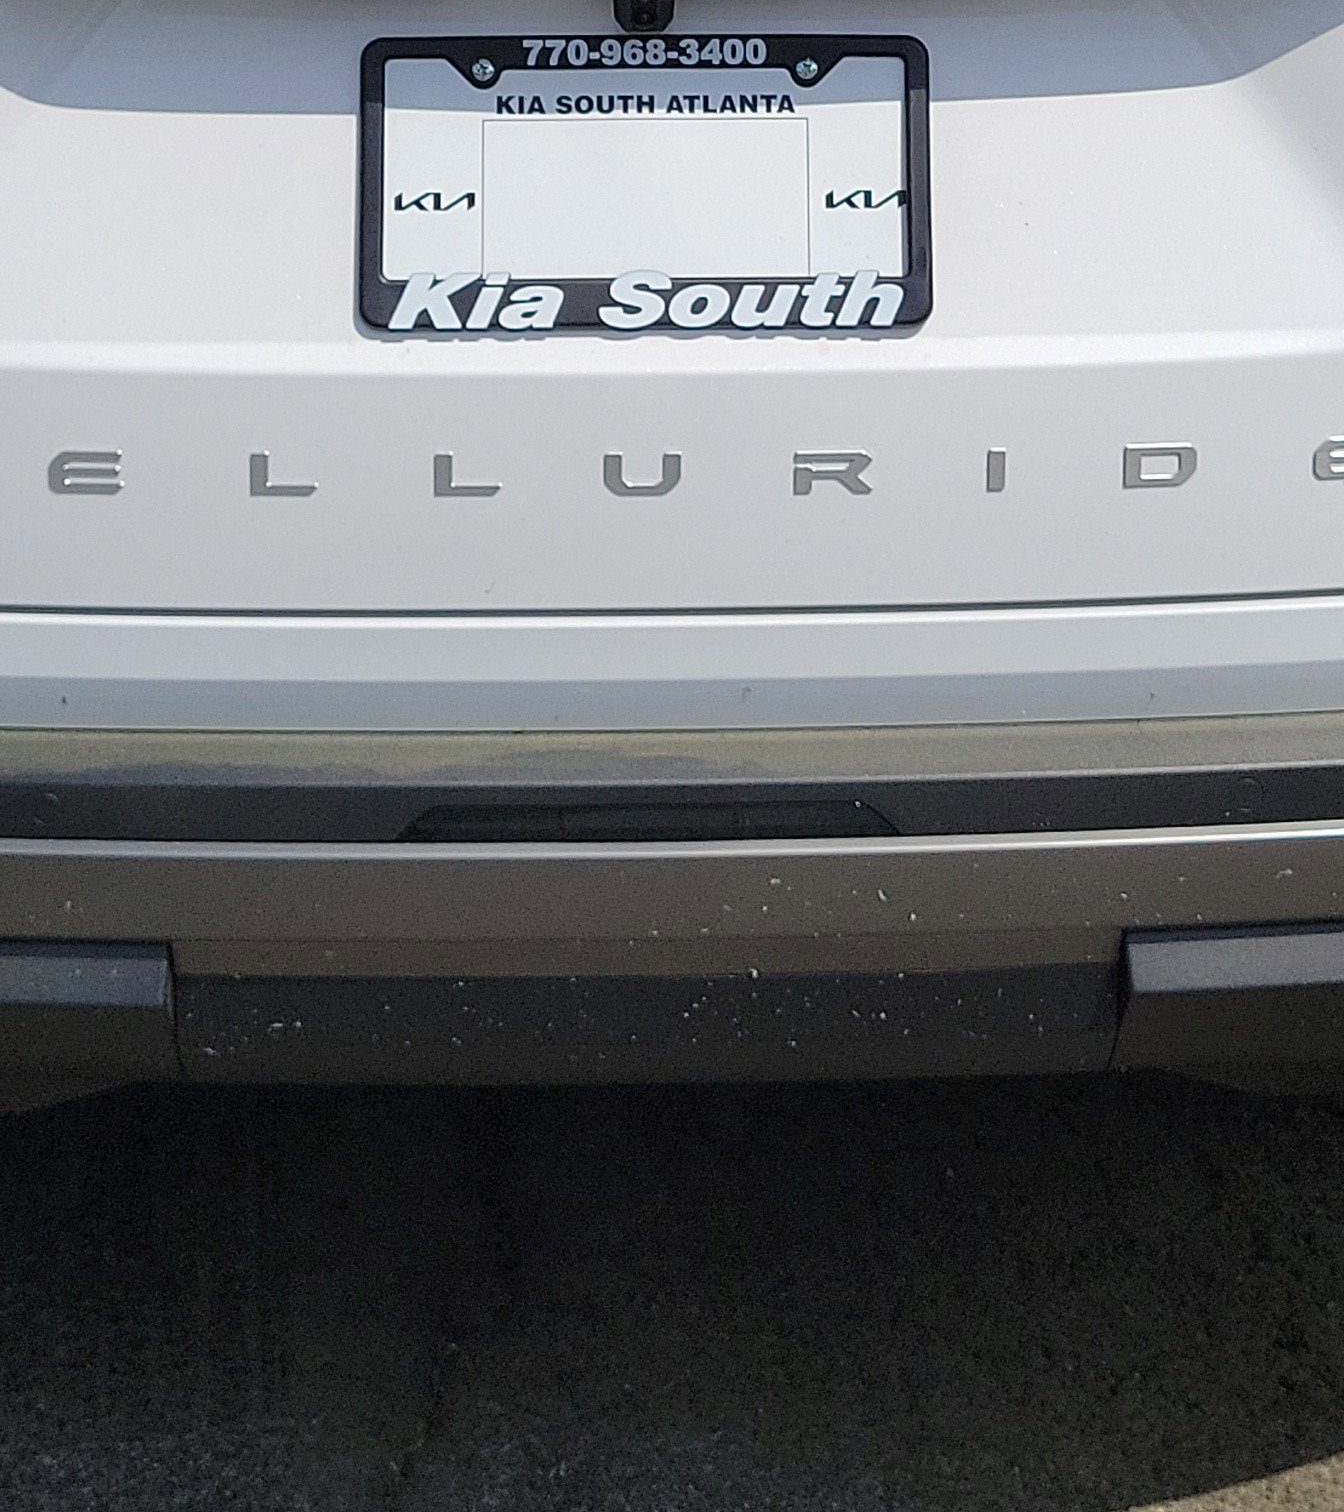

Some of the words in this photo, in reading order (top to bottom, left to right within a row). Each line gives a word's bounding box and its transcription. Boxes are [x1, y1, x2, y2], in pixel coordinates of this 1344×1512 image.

[522, 38, 768, 66] 770-968-3400
[496, 95, 546, 114] KIA
[555, 95, 656, 114] SOUTH
[665, 94, 796, 114] ATLANTA
[394, 191, 475, 212] KIA
[825, 189, 907, 211] KIA
[388, 272, 565, 332] Kia
[598, 268, 905, 330] South
